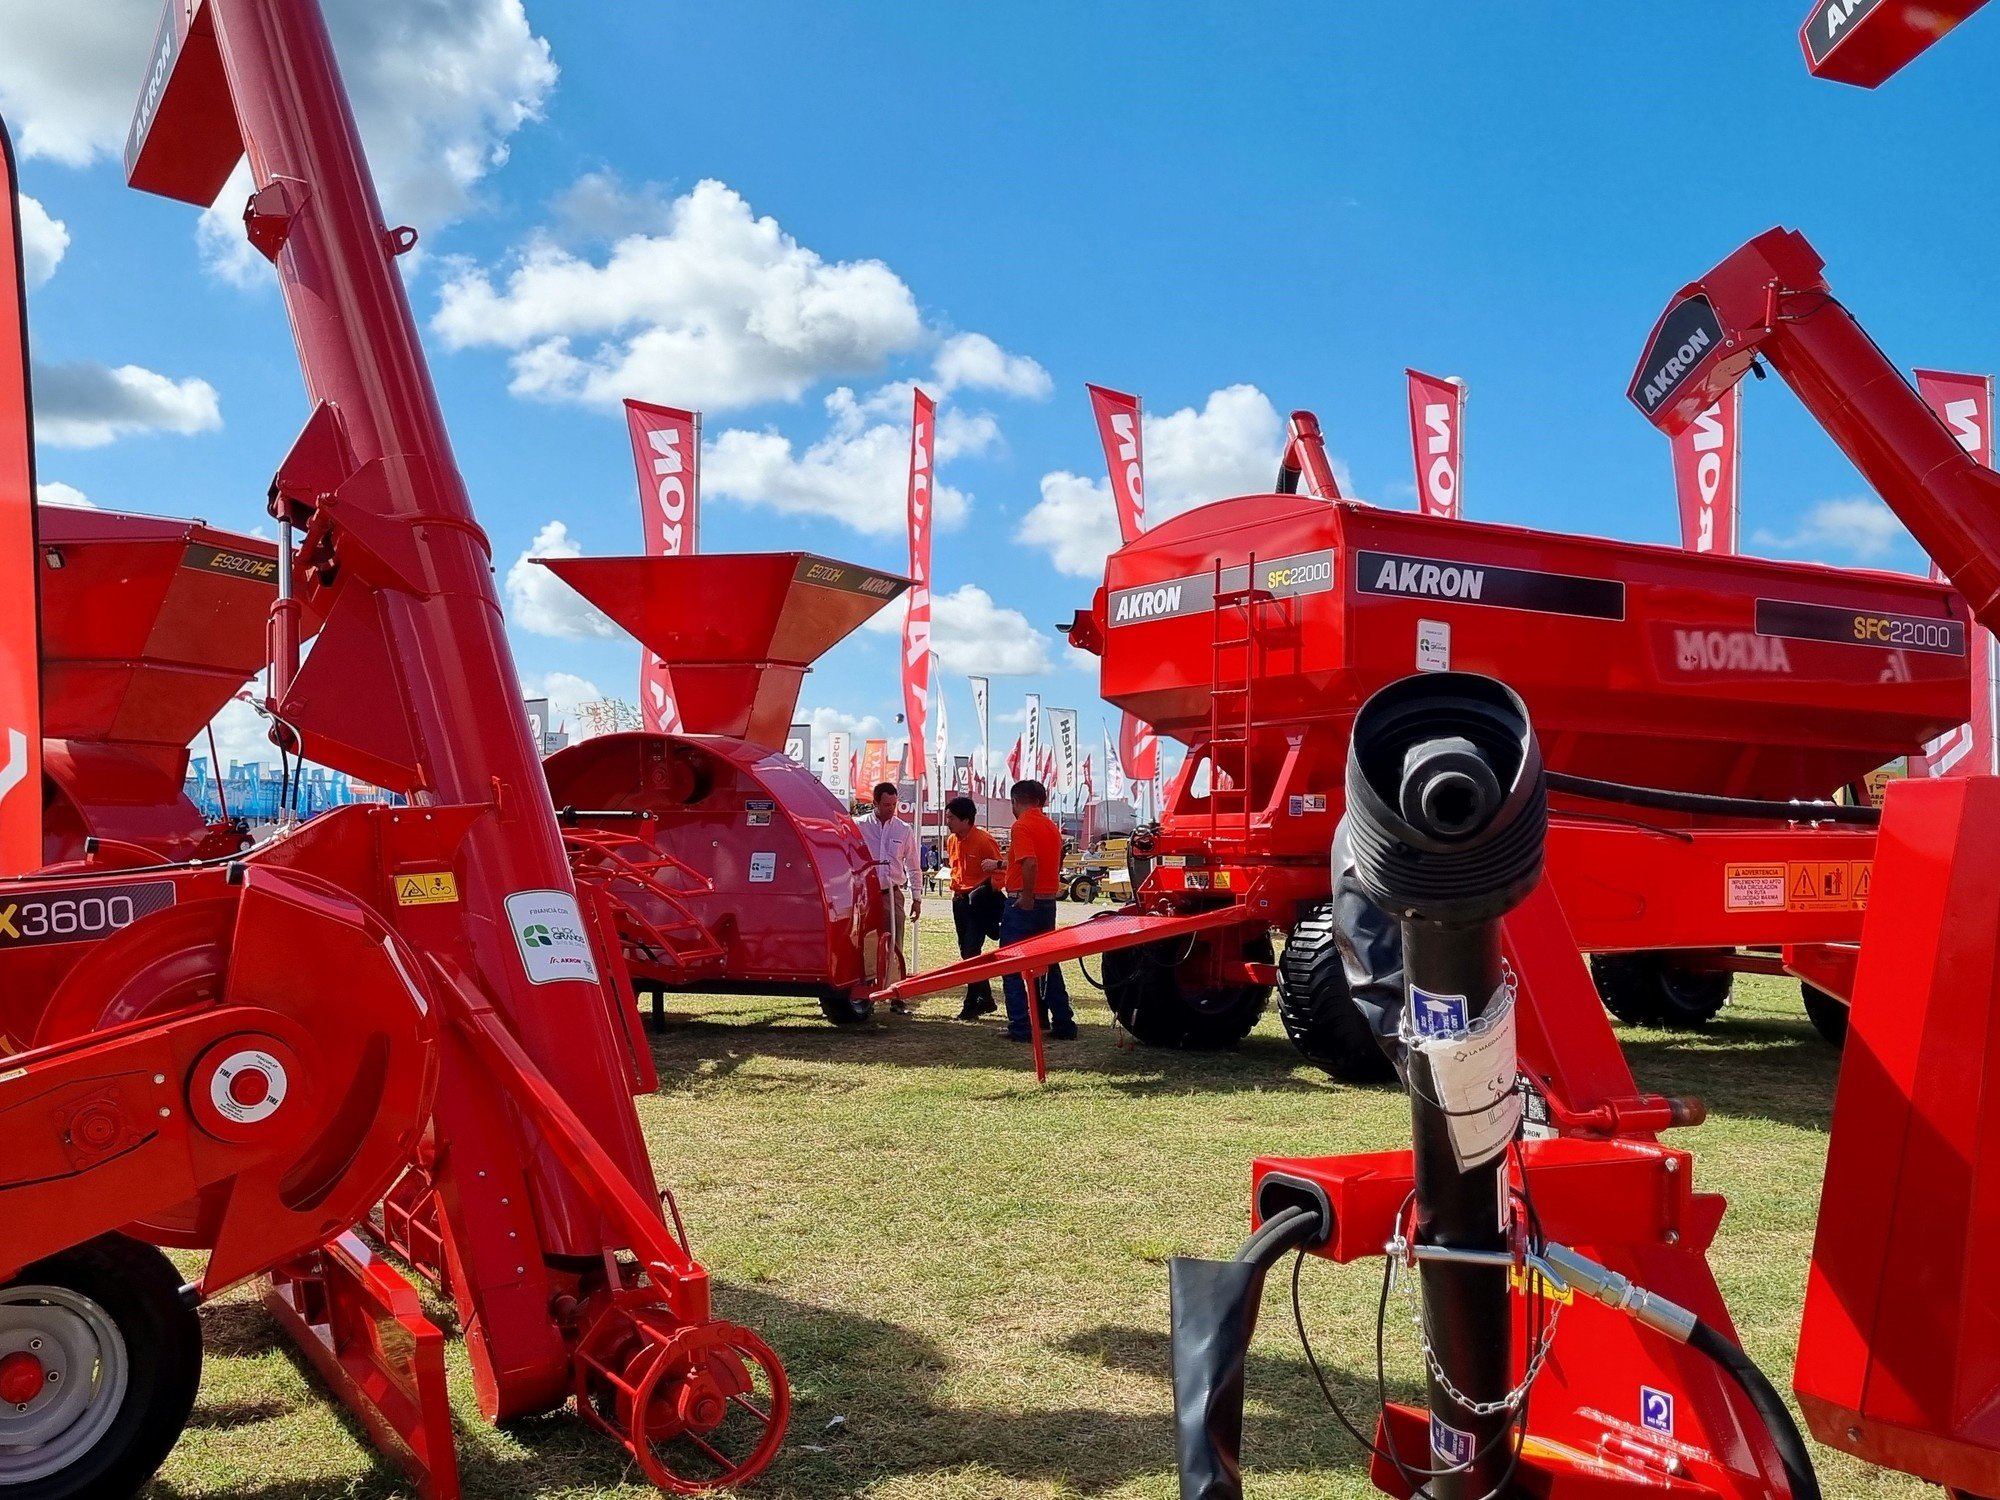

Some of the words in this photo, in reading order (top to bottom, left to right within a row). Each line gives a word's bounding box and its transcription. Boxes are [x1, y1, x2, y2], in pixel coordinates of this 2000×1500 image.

[135, 32, 171, 148] AKRON
[1645, 327, 1711, 407] AKRON
[210, 553, 276, 577] E9900HE
[1267, 562, 1330, 589] SFC22000
[857, 577, 898, 595] AKRON
[1375, 560, 1484, 600] AKRON
[1115, 585, 1183, 622] AKRON
[1853, 616, 1951, 648] SFC22000
[553, 932, 586, 944] GRANOS
[219, 1067, 232, 1079] TIRE
[266, 1094, 279, 1106] TIRE
[1523, 1129, 1541, 1138] KRON
